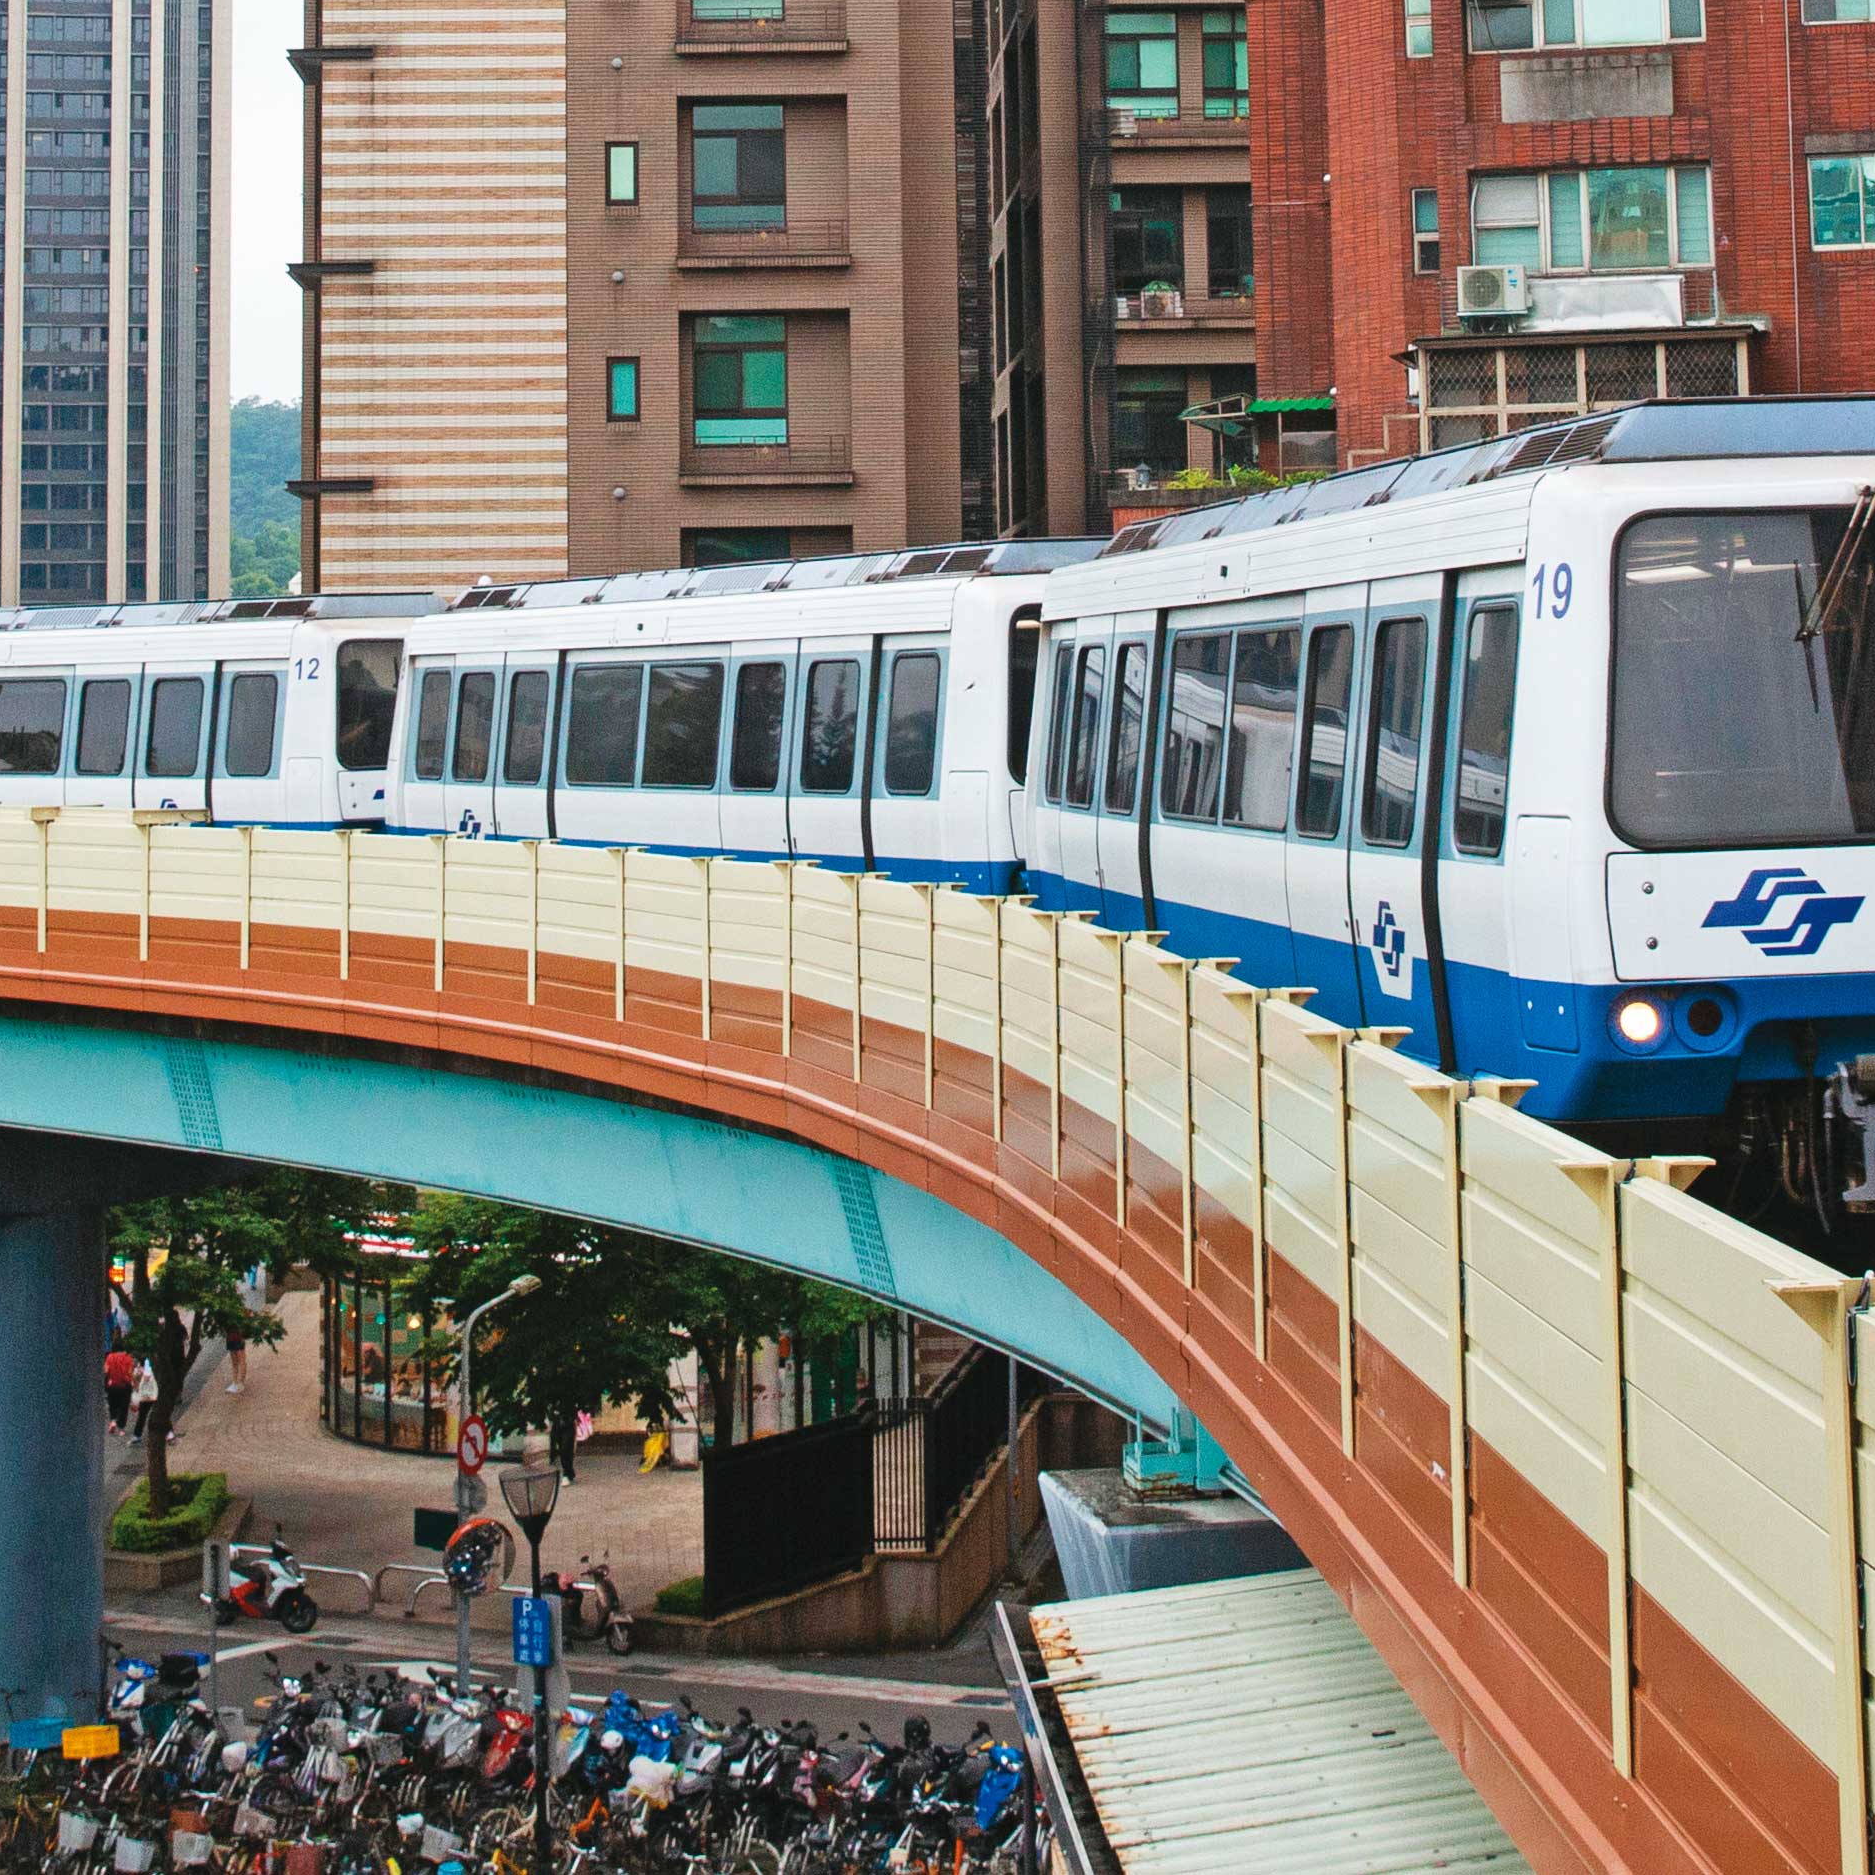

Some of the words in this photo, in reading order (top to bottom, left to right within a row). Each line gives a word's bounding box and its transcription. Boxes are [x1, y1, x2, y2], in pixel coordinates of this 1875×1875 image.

[1533, 562, 1572, 620] 19
[295, 657, 320, 680] 12
[522, 1599, 533, 1617] P
